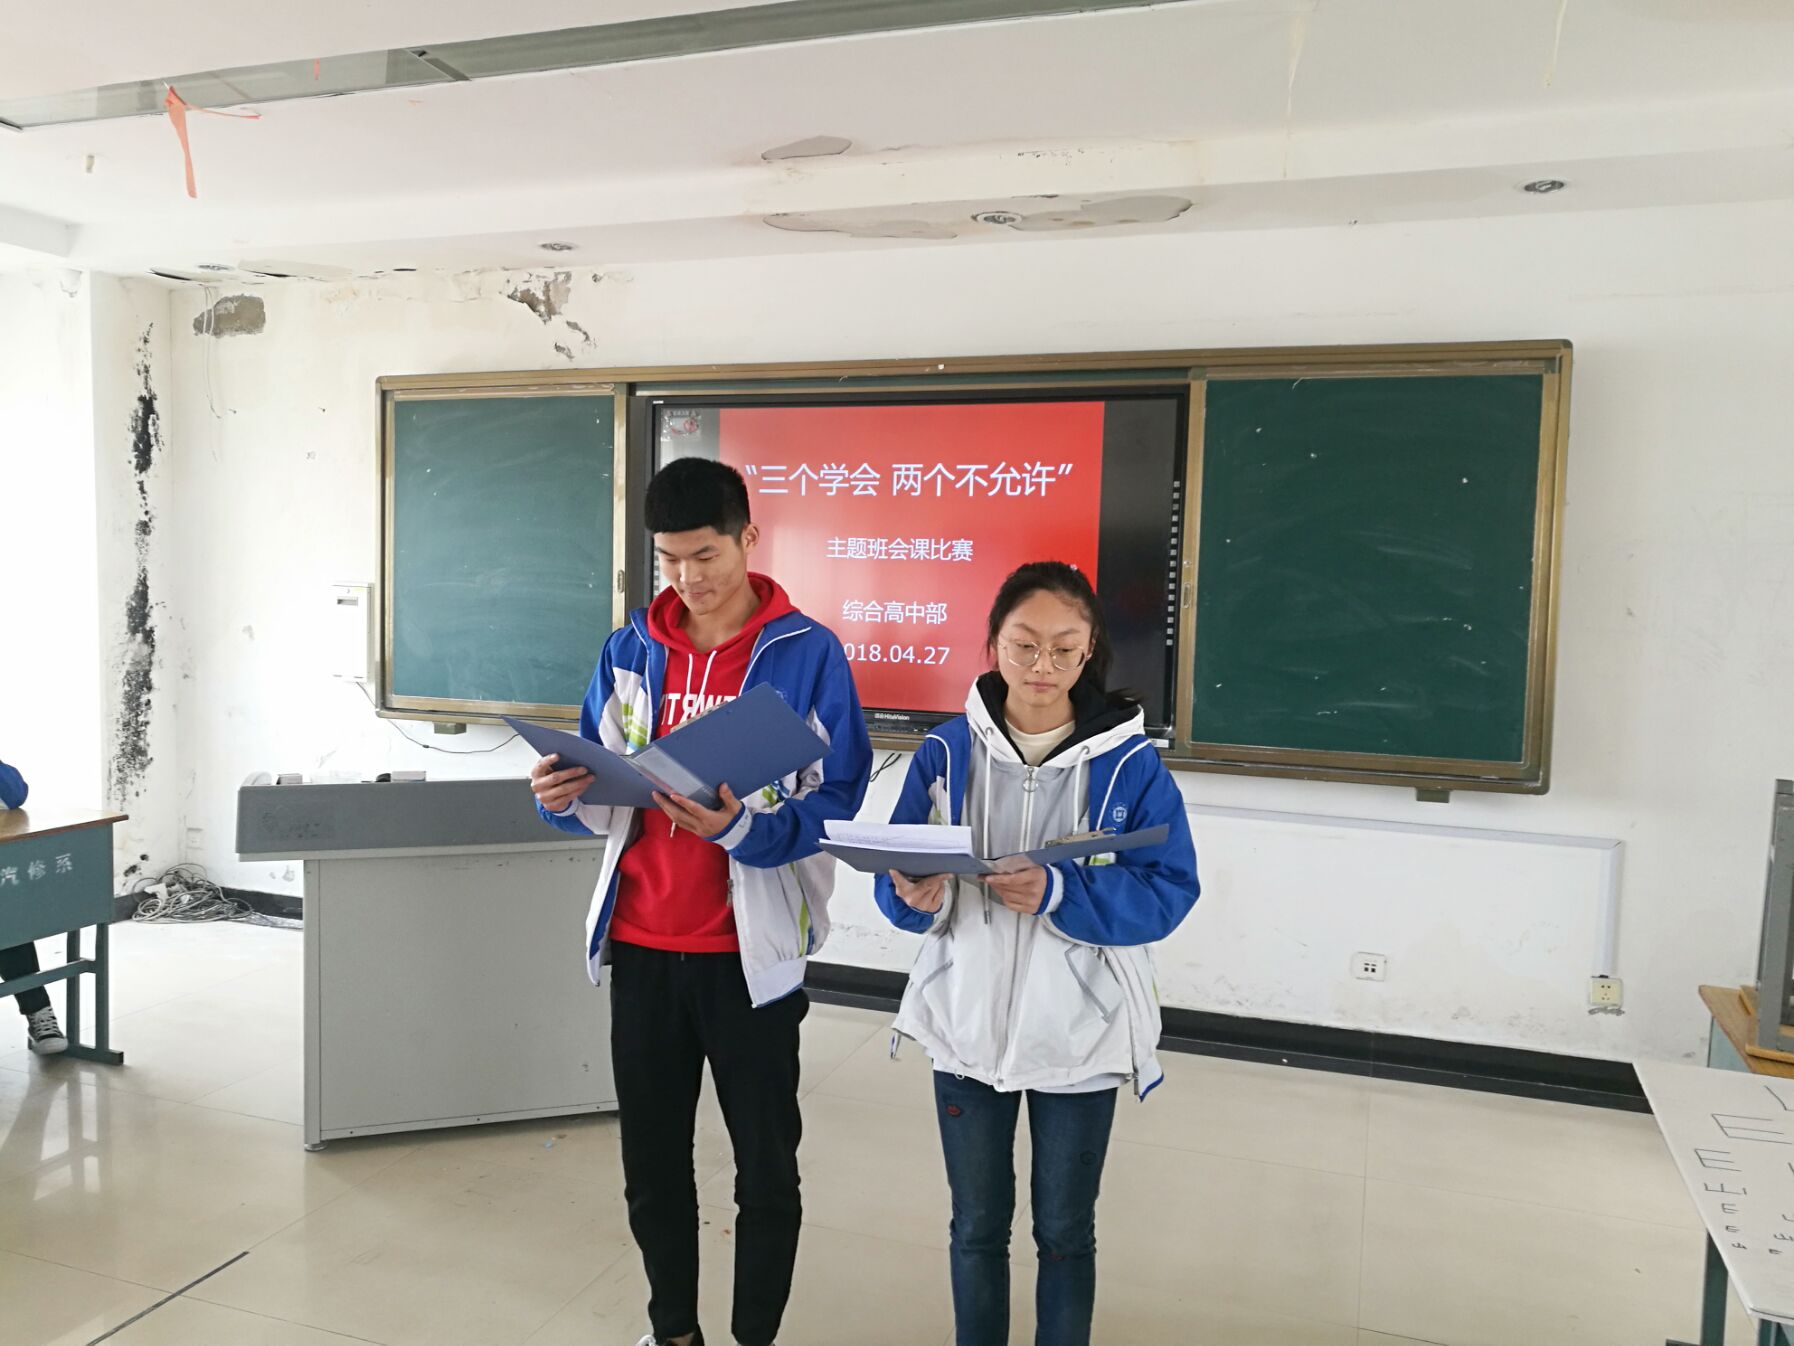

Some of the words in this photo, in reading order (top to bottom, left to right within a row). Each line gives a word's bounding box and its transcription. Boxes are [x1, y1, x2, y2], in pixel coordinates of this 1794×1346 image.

[826, 537, 974, 562] 主题班会课比赛
[842, 600, 948, 625] 综合高中部
[844, 643, 950, 665] 018.04.27
